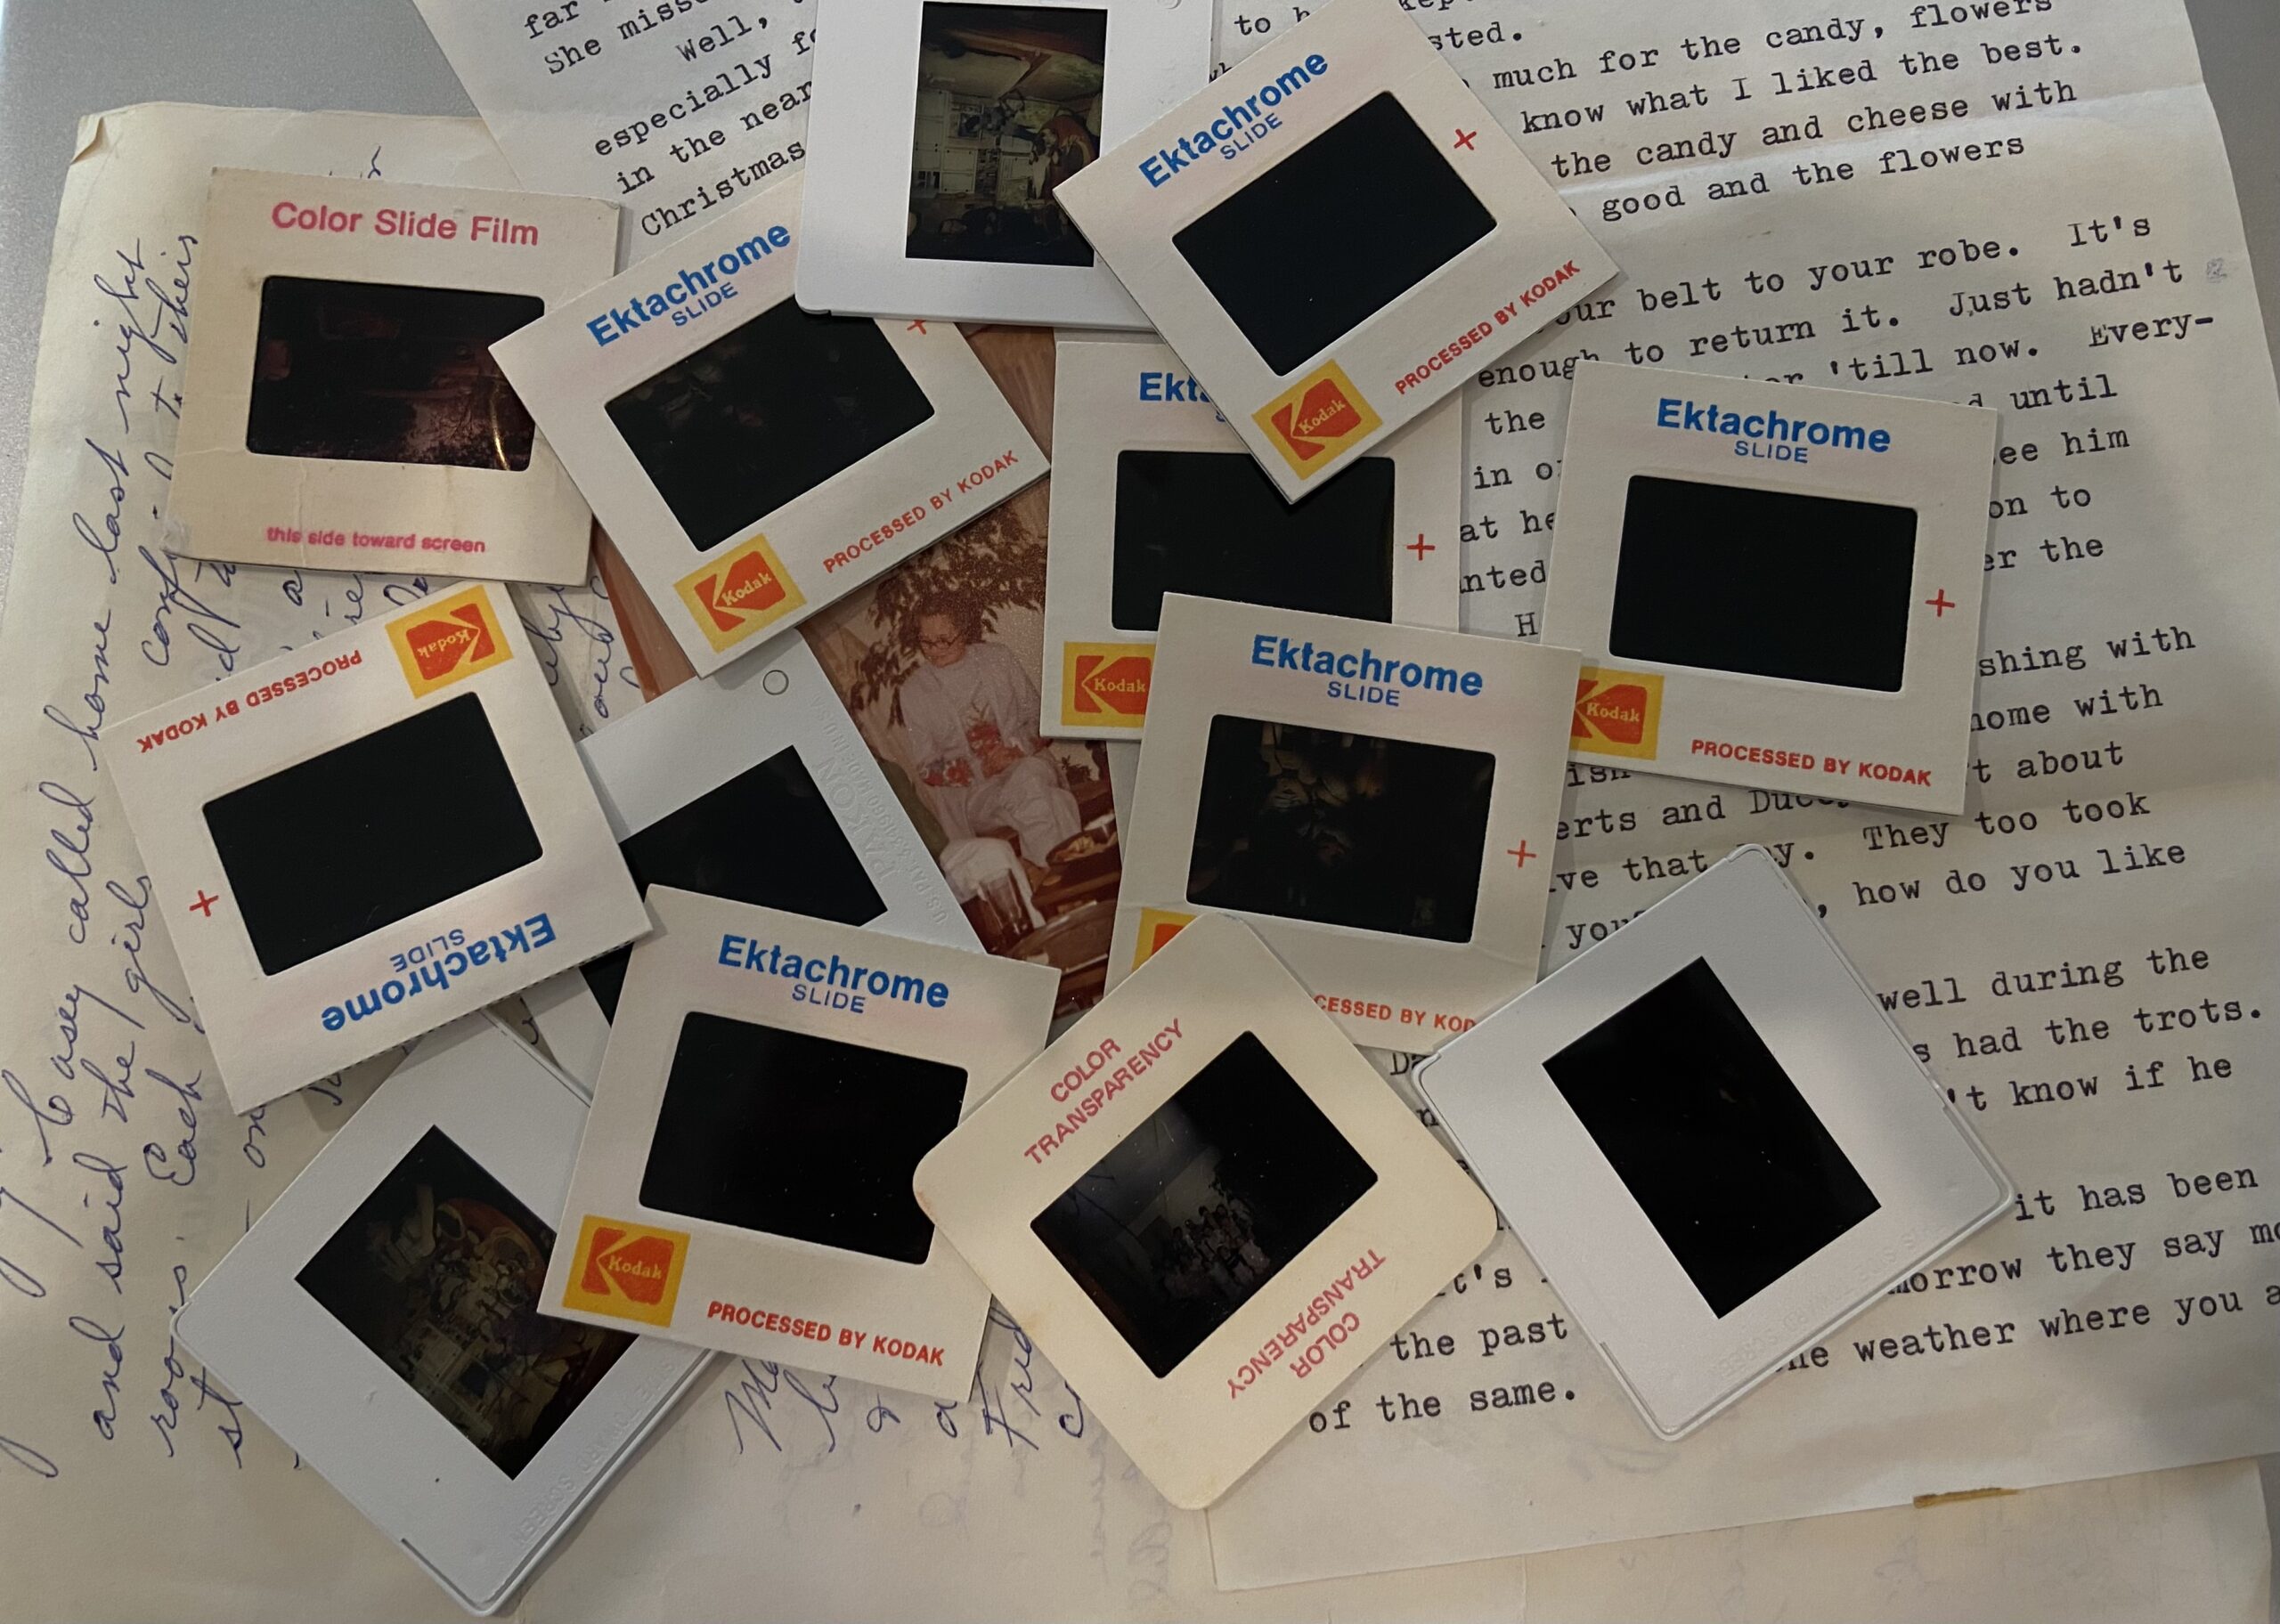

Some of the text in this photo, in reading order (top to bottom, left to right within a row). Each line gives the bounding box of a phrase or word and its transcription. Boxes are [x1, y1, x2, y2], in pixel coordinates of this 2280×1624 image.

[525, 0, 580, 38] far
[544, 0, 707, 75] She miss
[677, 14, 769, 62] Well,
[1234, 14, 1272, 36] to
[1429, 22, 1522, 51] sted.
[1494, 0, 2050, 89] much for the candy, flowers
[596, 53, 772, 156] especially
[1521, 34, 2082, 134] know what I liked the best.
[618, 81, 812, 194] in the near
[1139, 53, 1328, 188] Ektachrome
[1221, 112, 1282, 161] SLIDE
[1551, 80, 2079, 178] the candy and cheese with
[641, 140, 806, 236] Christmas
[1602, 134, 2026, 222] good and the flowers
[273, 202, 538, 246] Color Slide Film
[586, 225, 791, 347] Ektachrome
[1638, 215, 2151, 313] belt to your robe. It's
[672, 281, 738, 328] SLIDE
[1395, 260, 1580, 394] PROCESSED BY KODAK
[1625, 341, 1665, 366] to
[1690, 320, 1816, 357] return
[1843, 304, 1900, 334] it.
[1950, 282, 2032, 317] Just
[2056, 259, 2183, 301] hadn't
[94, 239, 176, 434] night
[1485, 313, 2214, 434] the 'till now. Every-
[2011, 374, 2118, 410] until
[1298, 399, 1347, 434] Kodak
[1657, 398, 1891, 452] Ektachrome
[1735, 441, 1809, 464] SLIDE
[1993, 427, 2130, 465] ee him
[1474, 466, 1512, 490] in
[1989, 485, 2091, 519] on to
[72, 438, 128, 584] last
[267, 526, 485, 553] this side toward screen
[823, 451, 1018, 574] PROCESSED BY KODAK
[2040, 536, 2105, 563] the
[721, 572, 772, 606] Kodak
[417, 629, 472, 658] Kodak
[1252, 634, 1483, 696] Ektachrome
[1978, 626, 2196, 677] shing with
[44, 610, 111, 771] home
[246, 650, 362, 708] PROCESSED
[1094, 678, 1146, 693] Kodak
[1327, 681, 1400, 707] SLIDE
[2074, 684, 2163, 717] with
[136, 713, 208, 753] KODAK
[215, 700, 240, 723] BY
[1586, 702, 1641, 722] Kodak
[1691, 740, 1932, 787] PROCESSED BY KODAK
[2017, 741, 2123, 779] about
[813, 755, 899, 882] PAKON
[1662, 796, 1726, 825] and
[1862, 792, 2151, 851] They too took
[38, 782, 96, 944] called
[1623, 849, 1708, 882] that
[1853, 843, 2186, 905] how do you like
[106, 875, 190, 1023] girls
[322, 913, 556, 1031] Ektachrome
[390, 930, 465, 972] SLIDE
[718, 934, 949, 1008] Ektachrome
[792, 984, 866, 1014] SLIDE
[1877, 946, 2209, 1011] well during the
[1401, 1009, 1425, 1026] BY
[1953, 997, 2261, 1059] had the trots.
[81, 1042, 135, 1122] the
[1024, 1018, 1182, 1164] TRANSPARENCY
[1051, 1038, 1121, 1102] COLOR
[2008, 1056, 2233, 1107] know if he
[143, 1069, 202, 1186] Each
[2015, 1167, 2259, 1222] it has been
[72, 1153, 127, 1295] said
[2047, 1227, 2225, 1274] they say
[608, 1255, 664, 1280] Kodak
[707, 1301, 945, 1366] PROCESSED BY KODAK
[1227, 1248, 1387, 1400] TRANSPARENCY
[1290, 1311, 1361, 1378] COLOR
[1389, 1331, 1454, 1361] the
[1478, 1313, 1568, 1357] past
[1852, 1319, 2015, 1362] weather
[2039, 1303, 2151, 1338] where
[2174, 1289, 2243, 1325] you
[69, 1317, 126, 1440] and
[1309, 1381, 1576, 1433] of the same.
